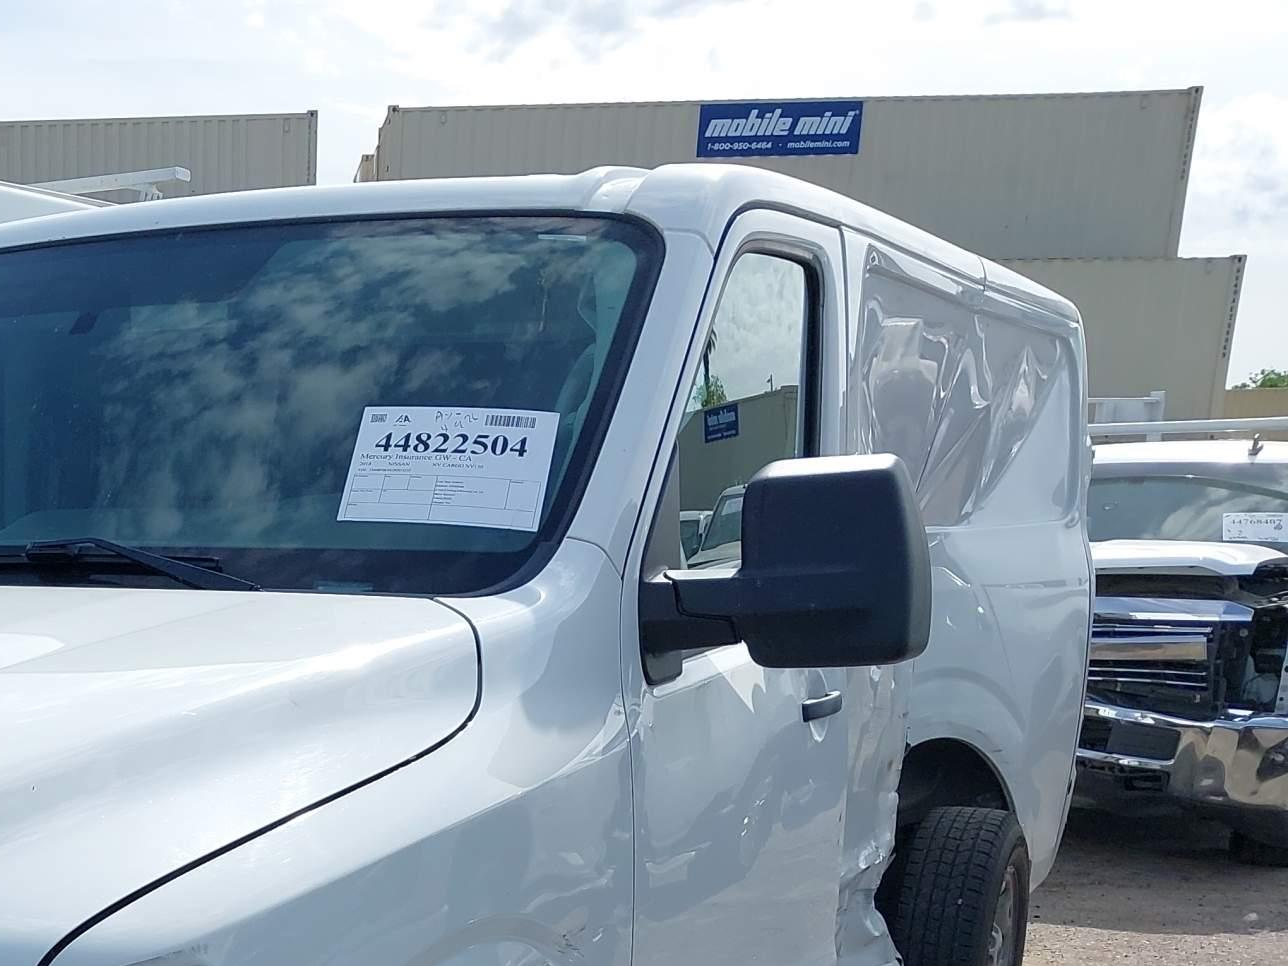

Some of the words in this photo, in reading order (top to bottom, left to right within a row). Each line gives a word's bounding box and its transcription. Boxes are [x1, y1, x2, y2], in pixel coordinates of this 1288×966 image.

[705, 108, 793, 137] mobile
[794, 110, 855, 135] mini
[787, 139, 850, 149] mobilemini.com
[375, 432, 528, 457] 44822504
[360, 453, 392, 461] Mercury
[395, 453, 433, 461] Insurance
